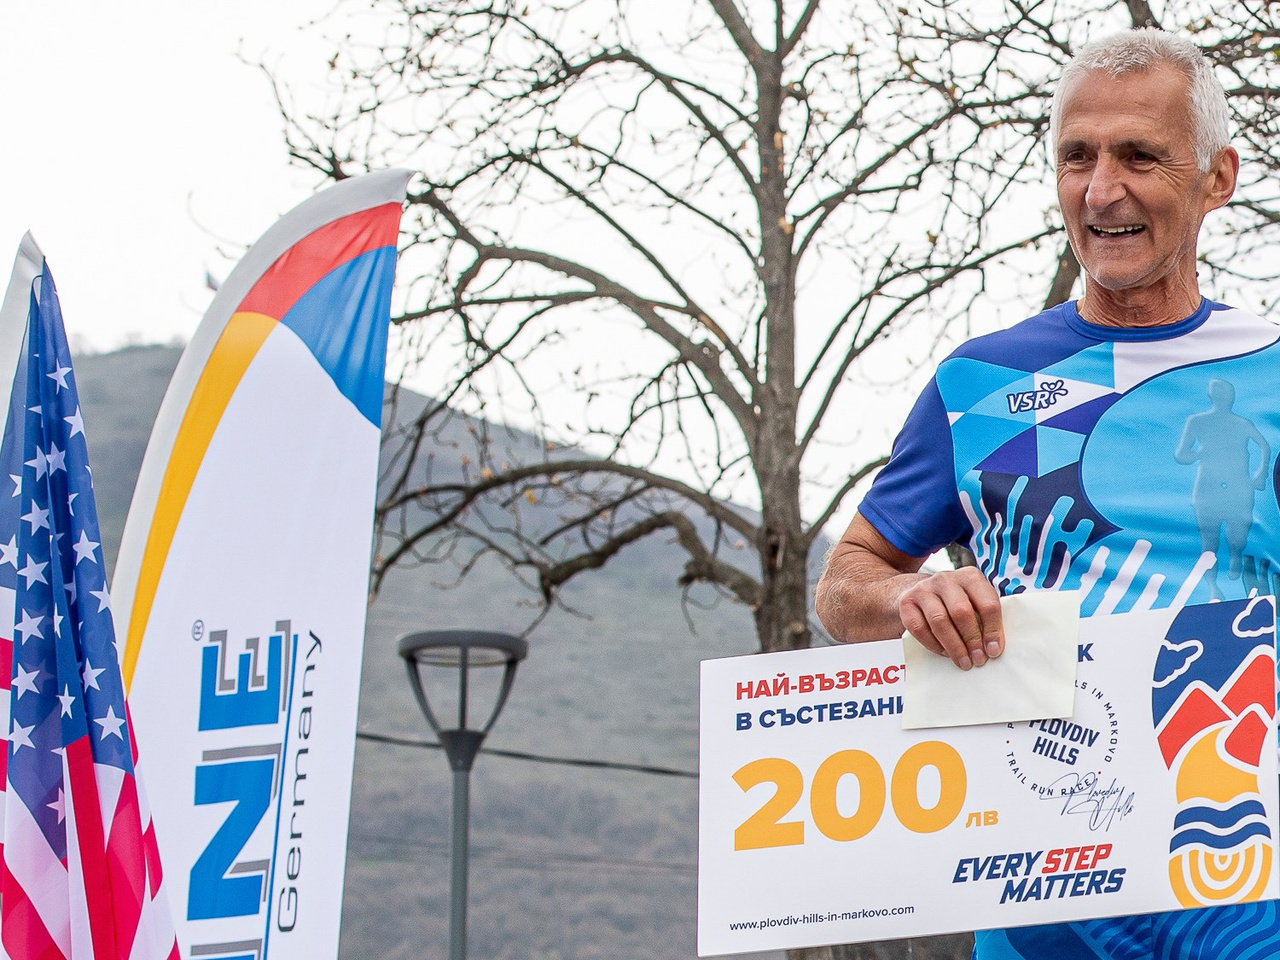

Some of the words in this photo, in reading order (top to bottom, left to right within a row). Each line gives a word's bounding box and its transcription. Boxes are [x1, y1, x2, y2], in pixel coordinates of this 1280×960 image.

[736, 712, 752, 731] В
[1091, 687, 1104, 700] IN
[1103, 701, 1119, 763] MARKOVO
[1032, 736, 1079, 766] HILLS
[277, 629, 322, 933] Germany
[1006, 751, 1026, 784] TRAIL
[1030, 783, 1054, 796] RUN
[1061, 778, 1091, 796] RACE
[731, 740, 968, 852] 200
[965, 810, 999, 829] лв
[952, 850, 1043, 884] EVERY
[1041, 843, 1113, 875] STEP
[999, 867, 1127, 905] MATTERS
[729, 905, 915, 931] www.plovdiv-hills-in-markovo.com
